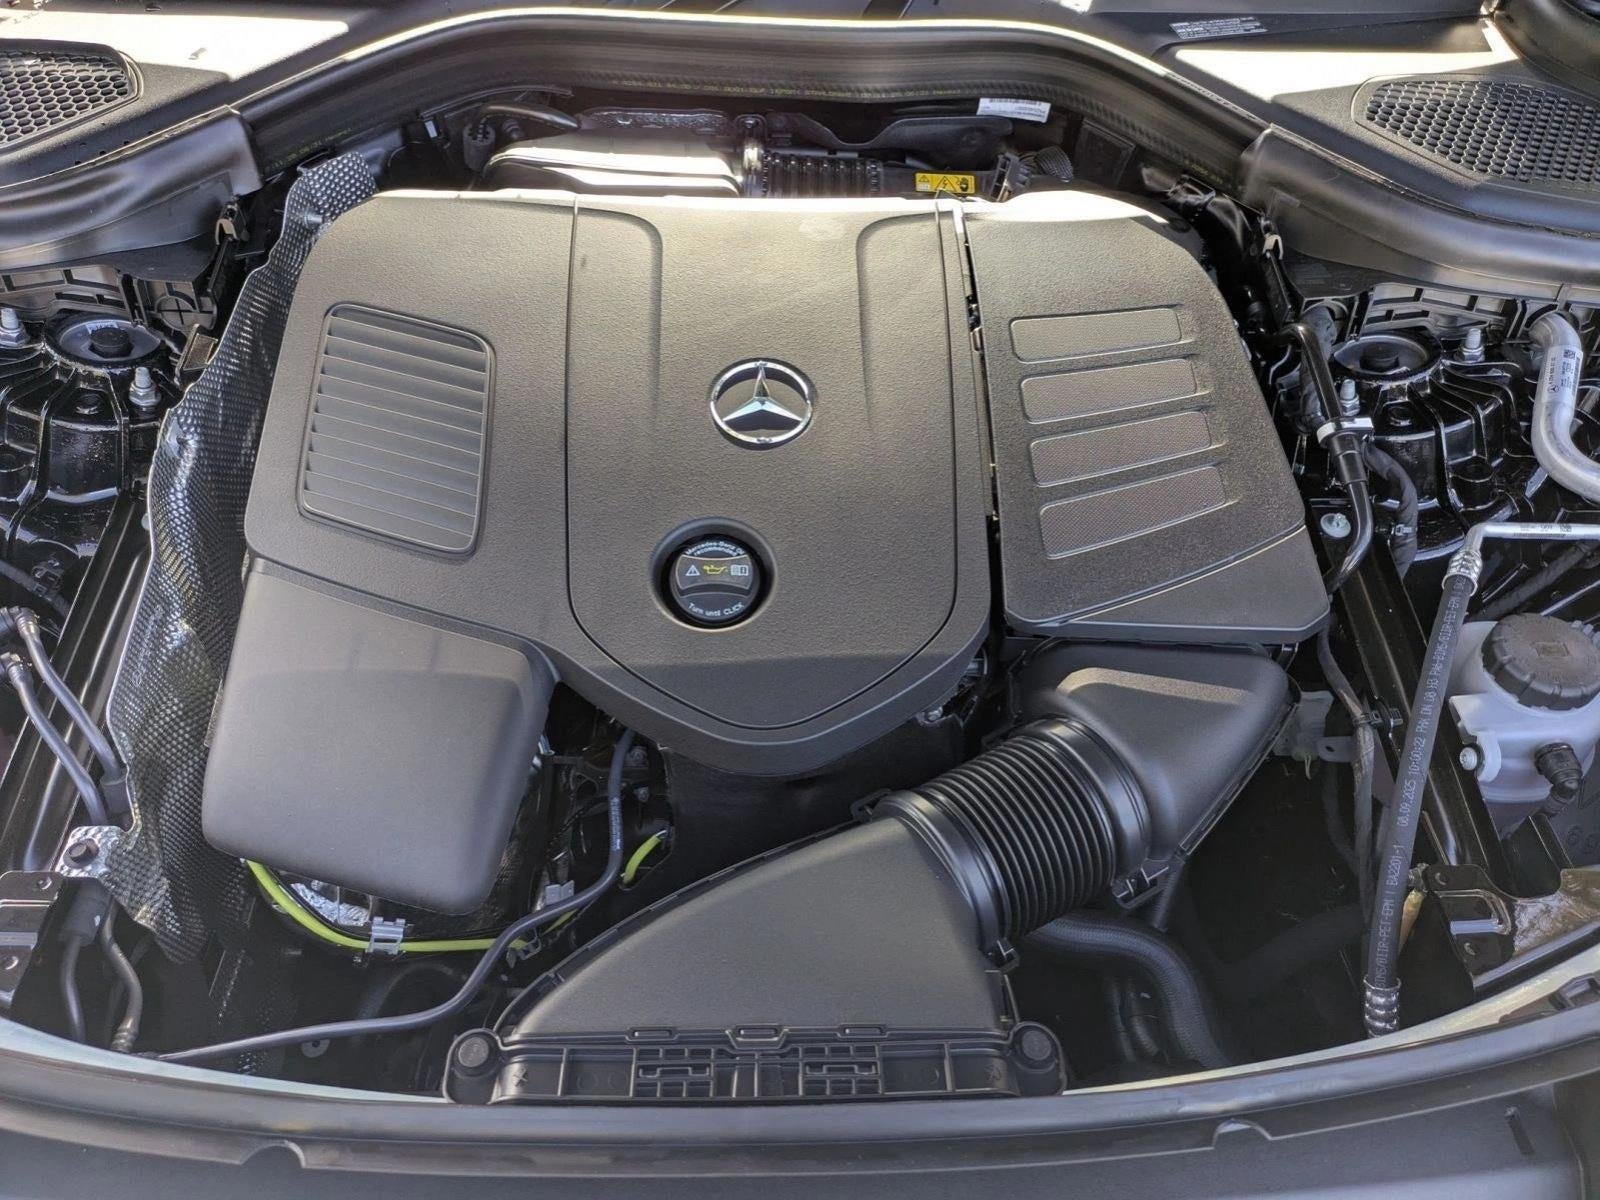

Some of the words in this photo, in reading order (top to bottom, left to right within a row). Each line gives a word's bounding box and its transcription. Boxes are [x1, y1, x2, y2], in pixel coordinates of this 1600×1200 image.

[688, 602, 704, 615] Turn
[705, 609, 721, 617] until
[723, 601, 745, 616] CLICK
